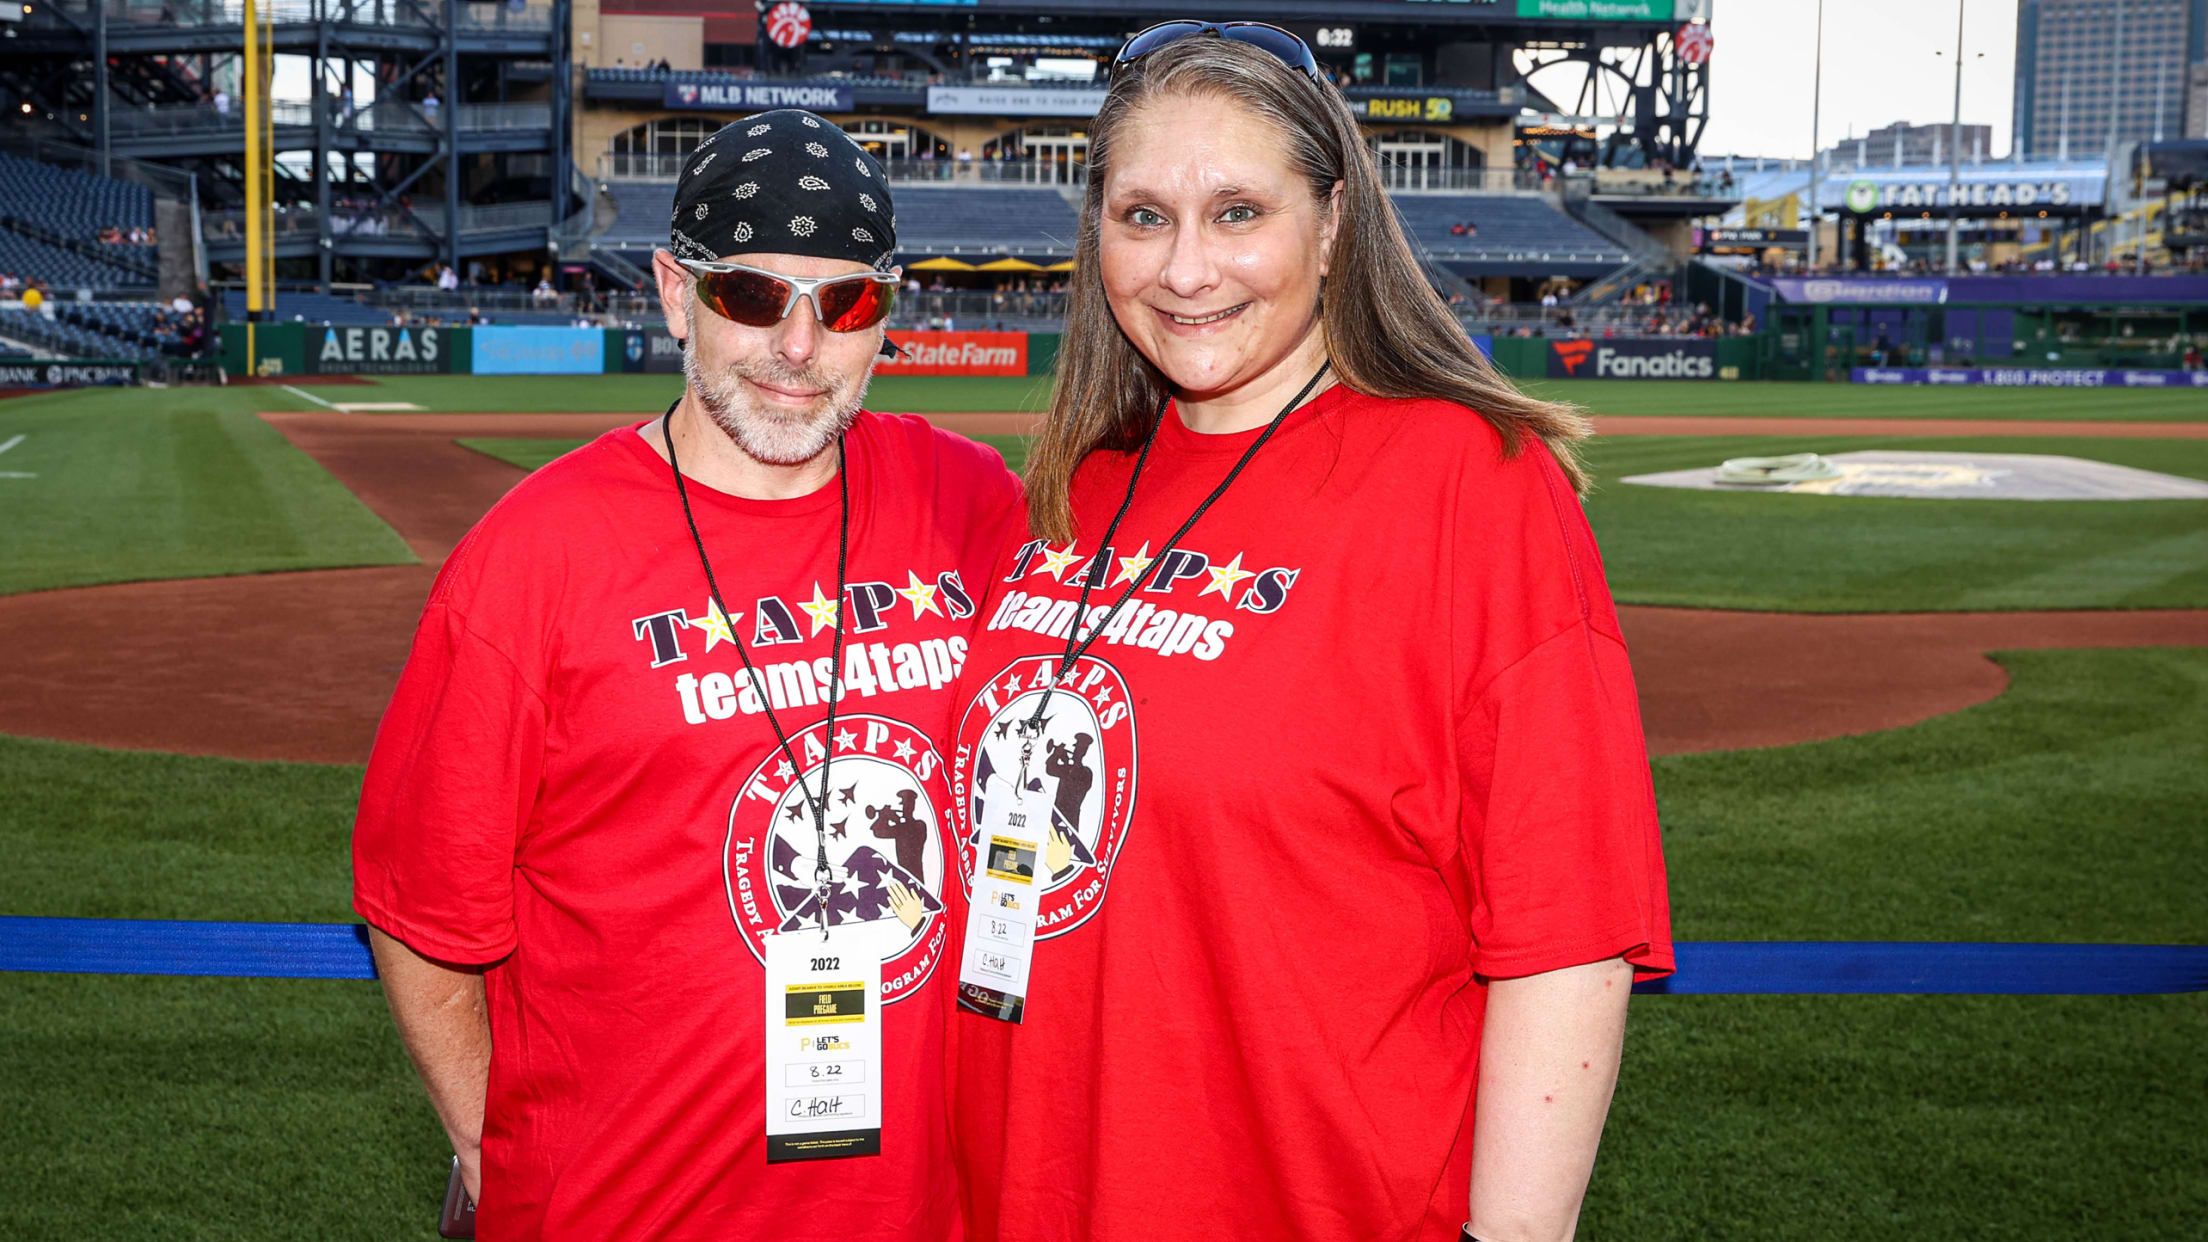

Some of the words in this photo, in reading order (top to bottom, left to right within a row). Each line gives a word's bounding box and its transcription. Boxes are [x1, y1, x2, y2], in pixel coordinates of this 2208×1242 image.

[1590, 1, 1650, 15] Network
[701, 85, 741, 104] MLB
[746, 86, 838, 106] NETWORK
[1368, 98, 1421, 118] RUSH
[1885, 184, 1938, 206] FAT
[1948, 182, 2071, 206] HEAD'S
[320, 327, 438, 361] AERAS
[1597, 348, 1713, 377] Fanatics
[986, 589, 1235, 662] teams4taps
[675, 635, 969, 725] teams4taps
[1008, 812, 1027, 828] 2022
[811, 957, 840, 972] 2022
[818, 994, 832, 1004] FIELD
[813, 1004, 837, 1015] PREGAME
